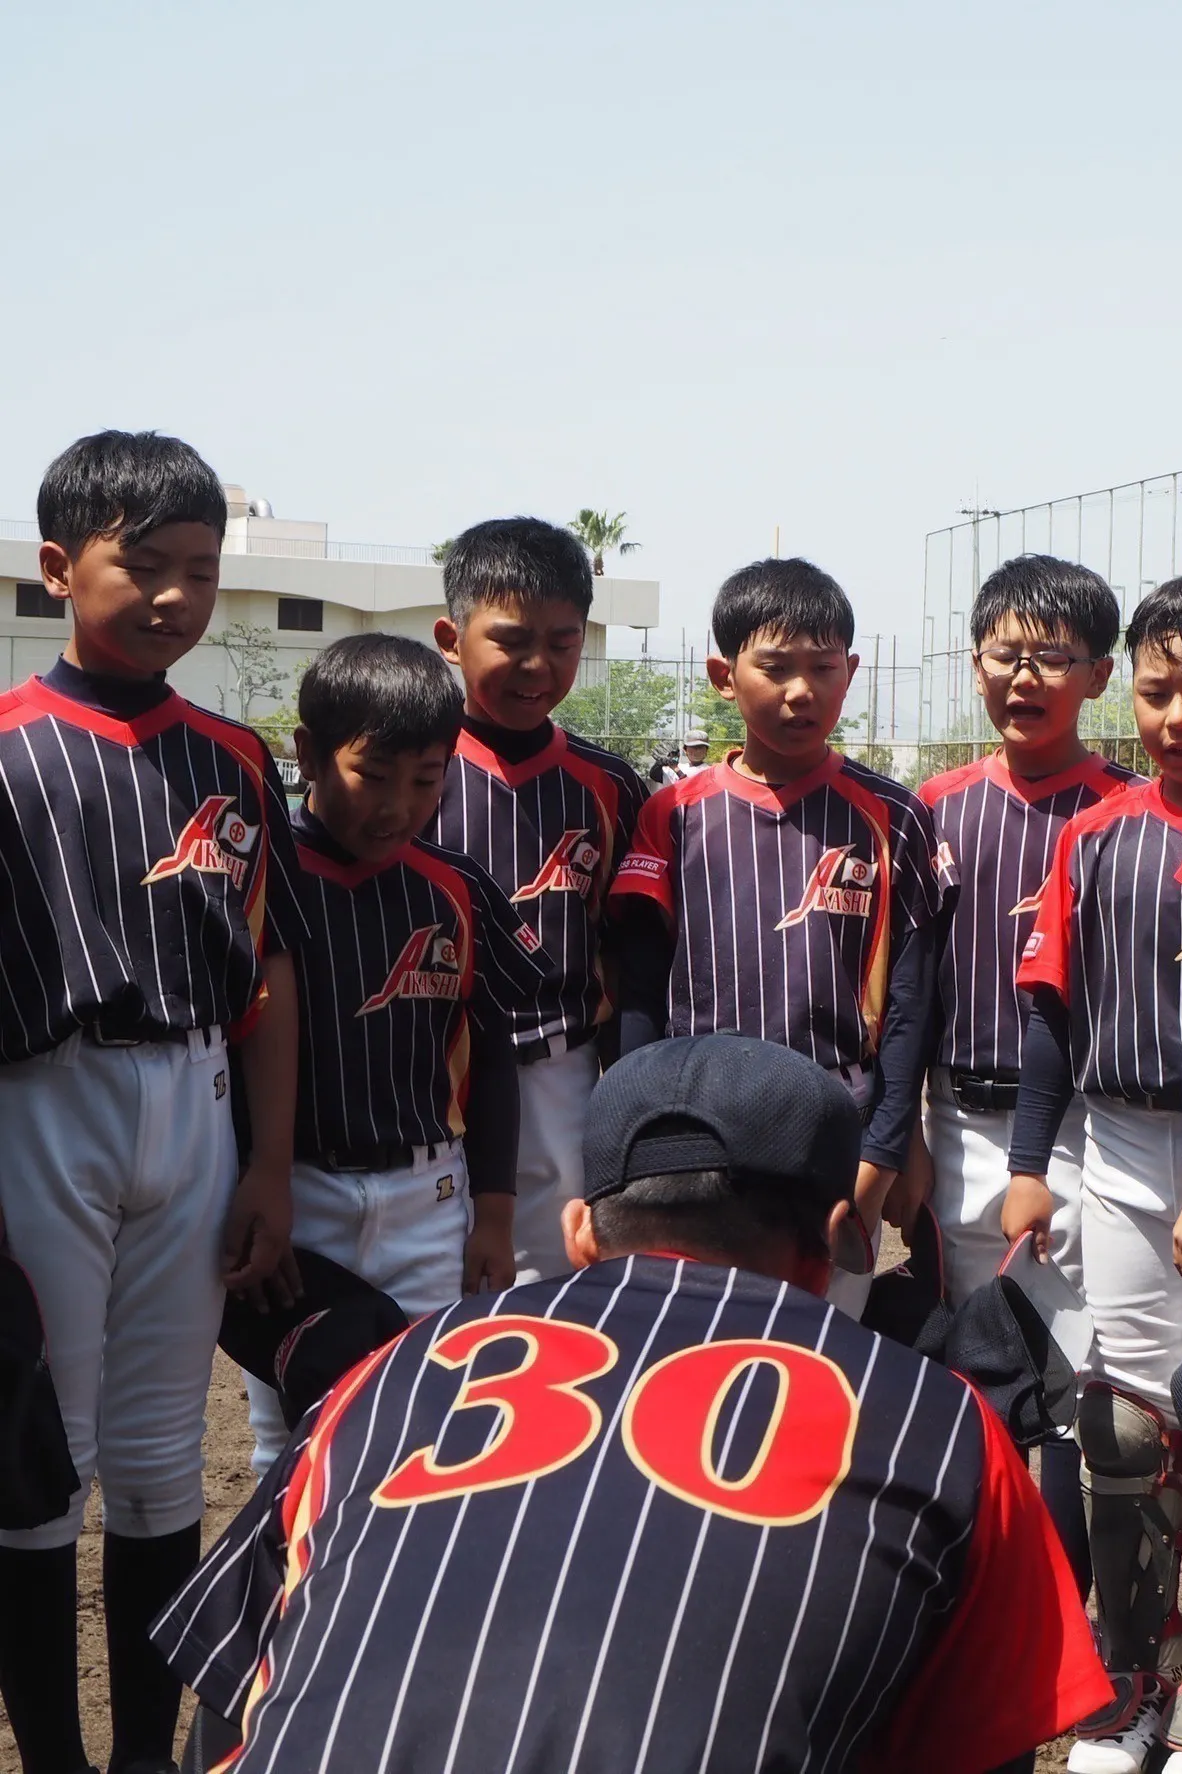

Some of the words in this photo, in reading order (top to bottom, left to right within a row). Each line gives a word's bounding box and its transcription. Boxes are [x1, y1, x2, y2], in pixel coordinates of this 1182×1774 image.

[630, 860, 659, 871] PLAYER
[774, 843, 872, 931] AKASHI
[354, 923, 460, 1018] AKASHI
[370, 1314, 859, 1526] 30
